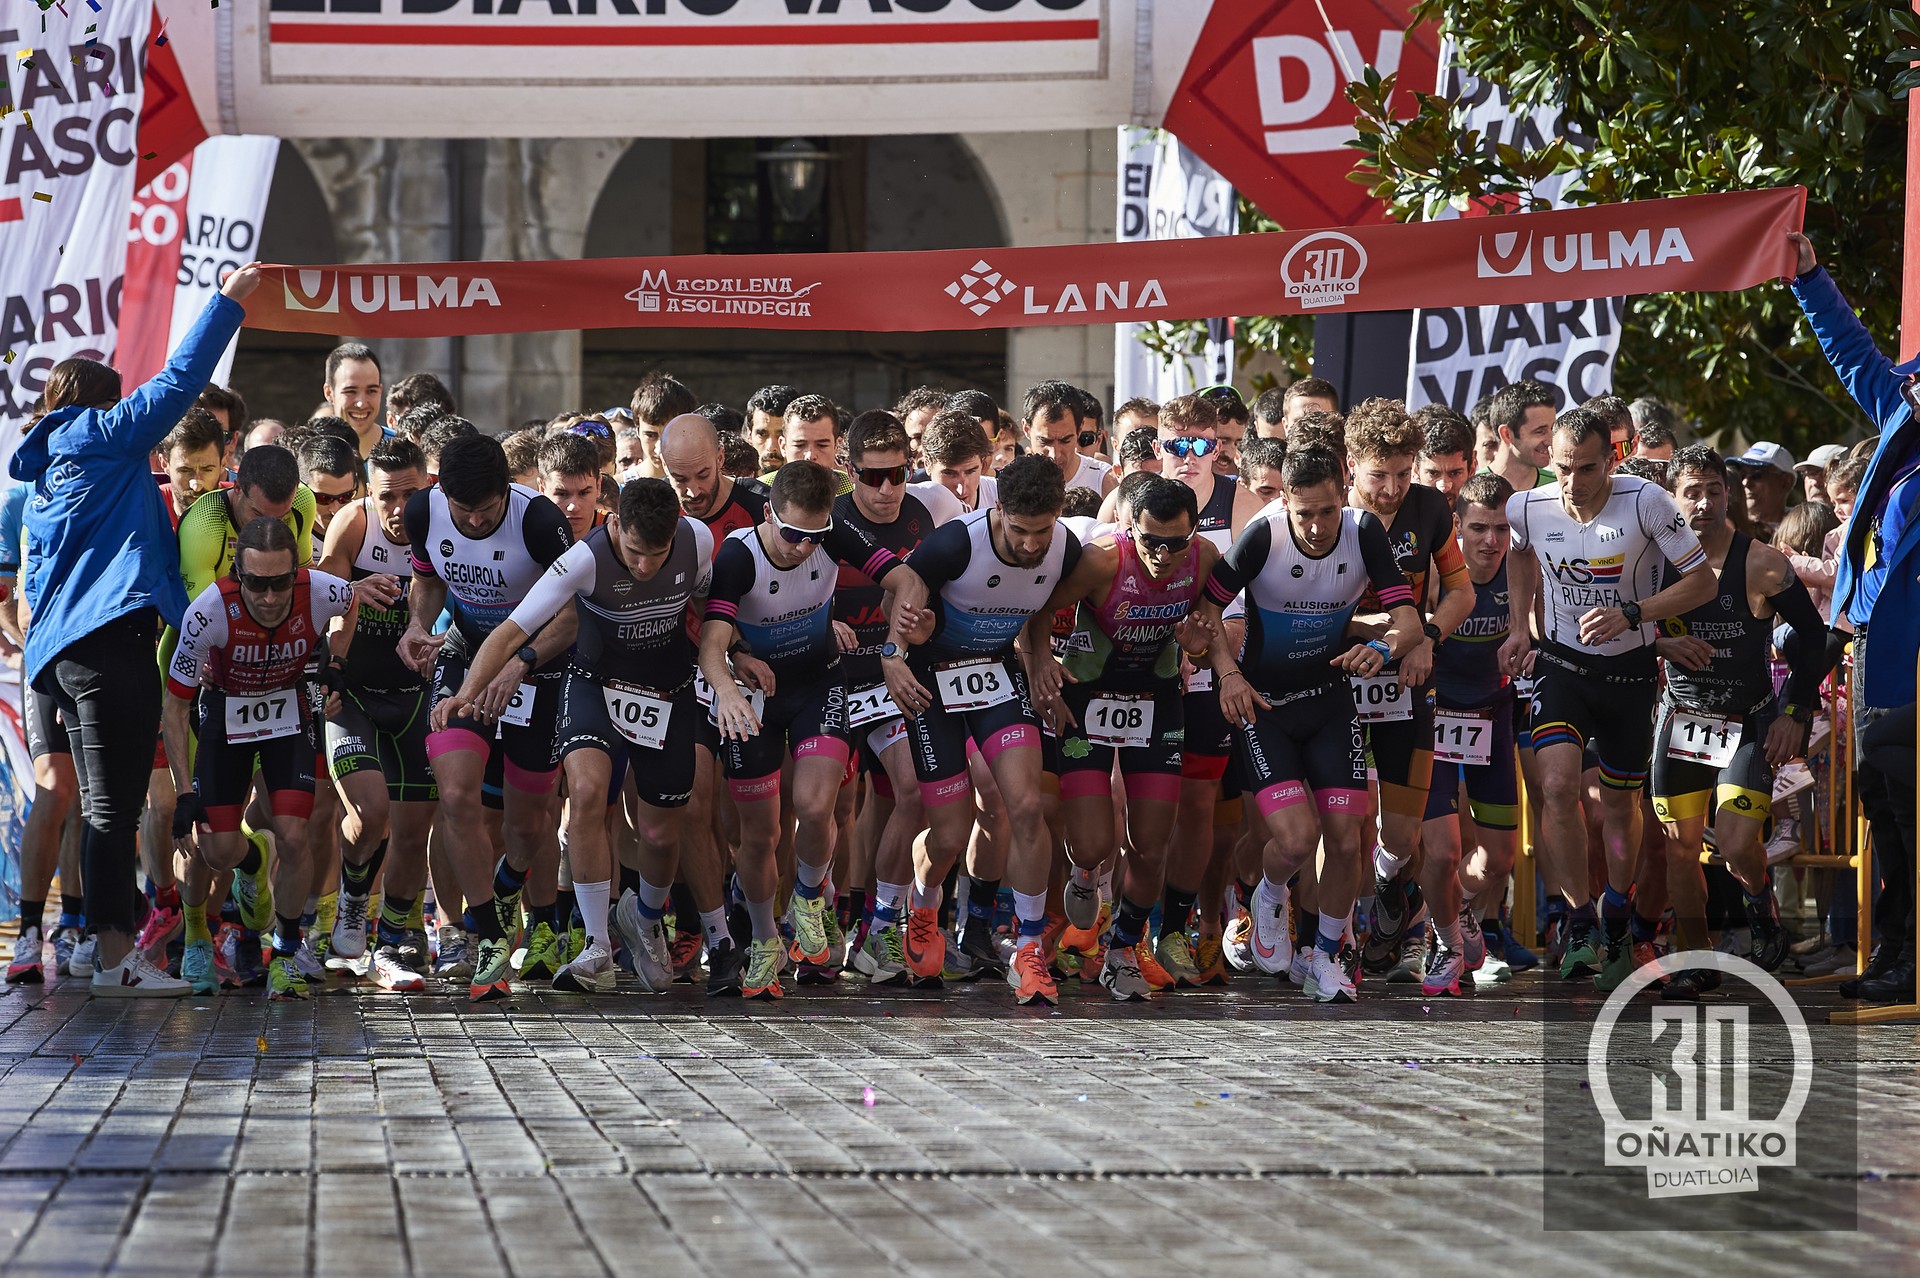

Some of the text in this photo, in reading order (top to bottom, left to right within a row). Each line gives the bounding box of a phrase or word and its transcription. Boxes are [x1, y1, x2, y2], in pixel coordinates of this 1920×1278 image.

[1252, 30, 1403, 126] DV
[1542, 227, 1694, 272] ULMA
[640, 268, 794, 294] MAGDALENA
[1289, 281, 1356, 295] OÑATIKO
[350, 274, 502, 314] ULMA
[637, 290, 812, 317] GASOLINDEGIA
[1023, 279, 1169, 315] LANA
[1303, 294, 1343, 305] DUATLOIA
[843, 518, 873, 548] GSPORT
[444, 561, 508, 589] SEGUROLA
[454, 583, 504, 599] PEÑOTA
[1561, 586, 1623, 608] RUZAFA
[761, 601, 823, 623] ALUSIGMA
[968, 606, 1037, 615] ALUSIGMA
[1127, 599, 1190, 620] SALTOKI
[1283, 600, 1347, 610] ALUSIGMA
[617, 615, 679, 639] ETXEBARRIA
[1454, 613, 1510, 636] ROTZENA
[1691, 621, 1743, 632] ELECTRO
[1692, 629, 1747, 641] ALAVESA
[231, 638, 308, 663] BILBAO
[769, 643, 812, 660] GSPORT
[1288, 644, 1329, 660] GSPORT
[949, 671, 1000, 697] 103
[1352, 682, 1401, 705] 109
[236, 698, 287, 724] 107
[611, 698, 660, 728] 105
[1096, 706, 1143, 730] 108
[331, 736, 362, 751] BASQUE
[916, 711, 938, 772] ALUSIGMA
[1001, 727, 1025, 747] psi
[1434, 722, 1483, 747] 117
[1683, 721, 1730, 748] 111
[333, 744, 367, 759] COUNTRY
[1248, 730, 1272, 780] ALUSIGMA
[1349, 715, 1366, 780] PEÑOTA
[1327, 794, 1349, 809] psi
